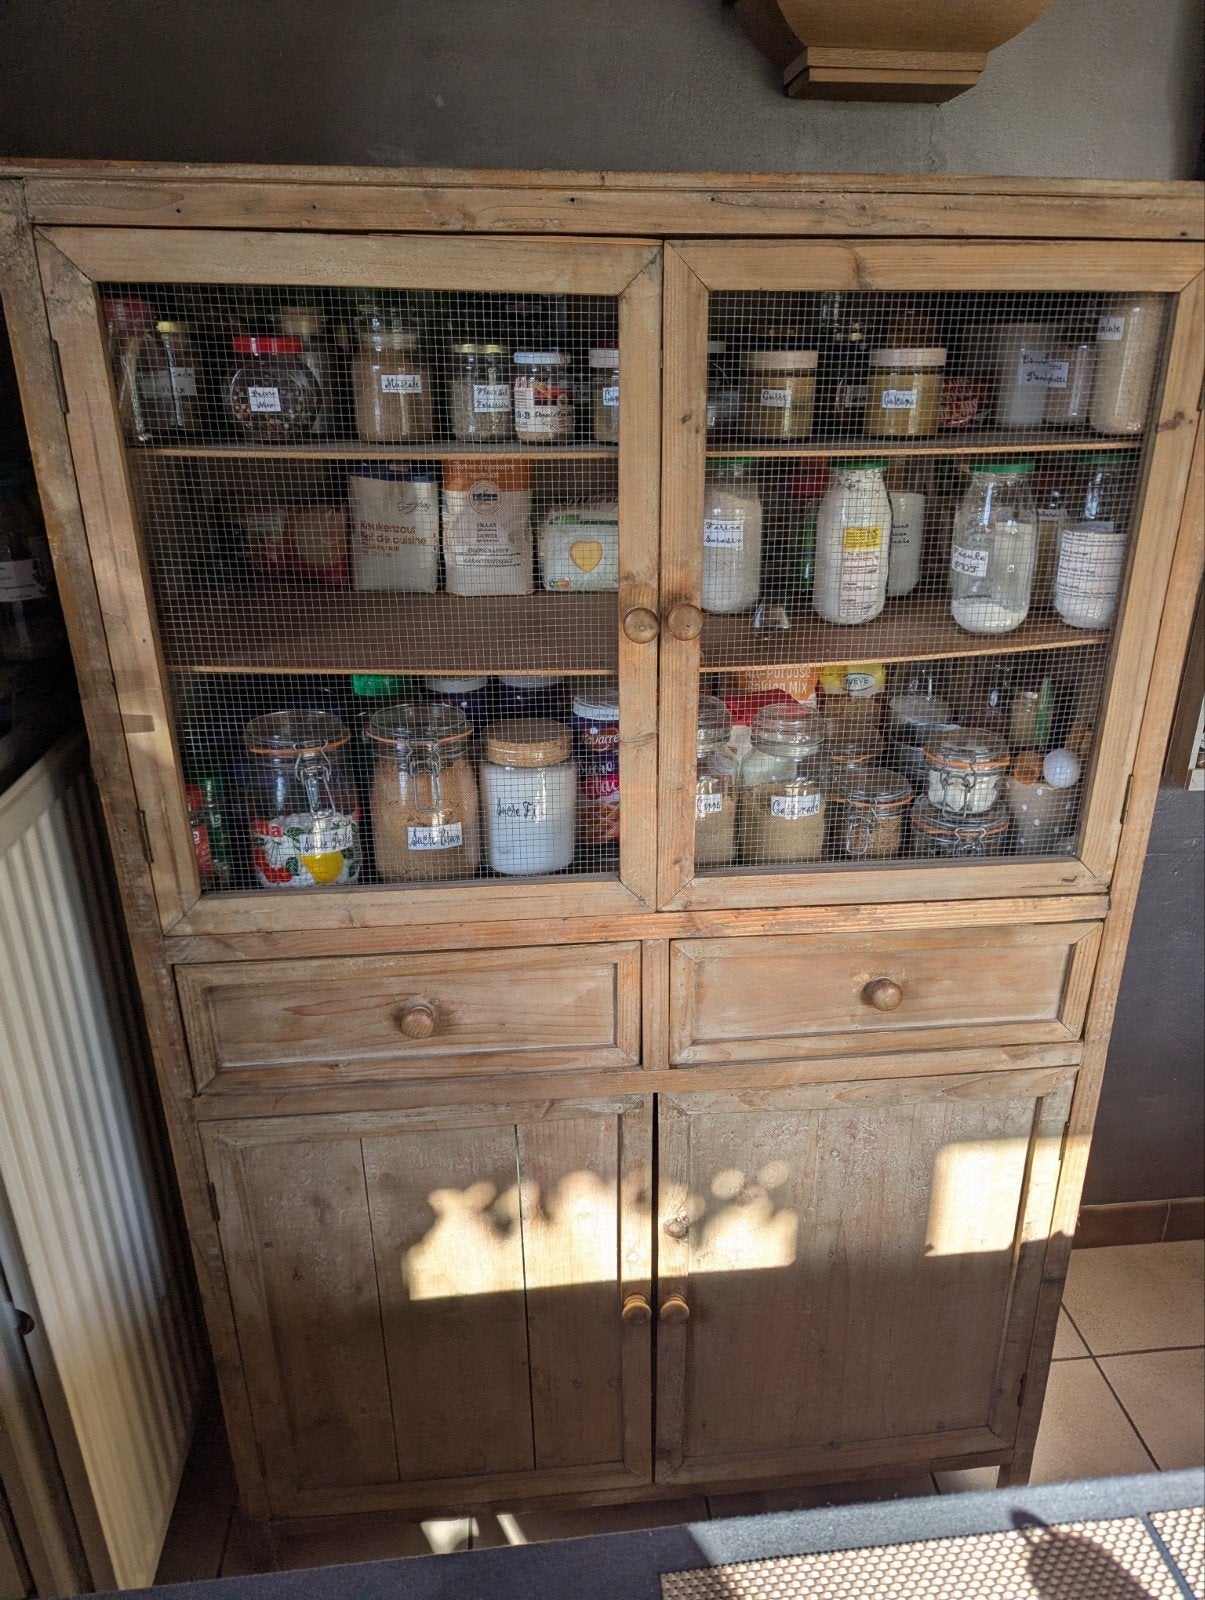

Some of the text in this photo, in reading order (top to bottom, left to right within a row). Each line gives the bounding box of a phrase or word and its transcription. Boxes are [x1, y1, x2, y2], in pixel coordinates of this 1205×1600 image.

[360, 521, 416, 534] Keukenzout
[377, 533, 389, 543] de
[393, 535, 427, 545] cuisine
[790, 680, 808, 693] Mix
